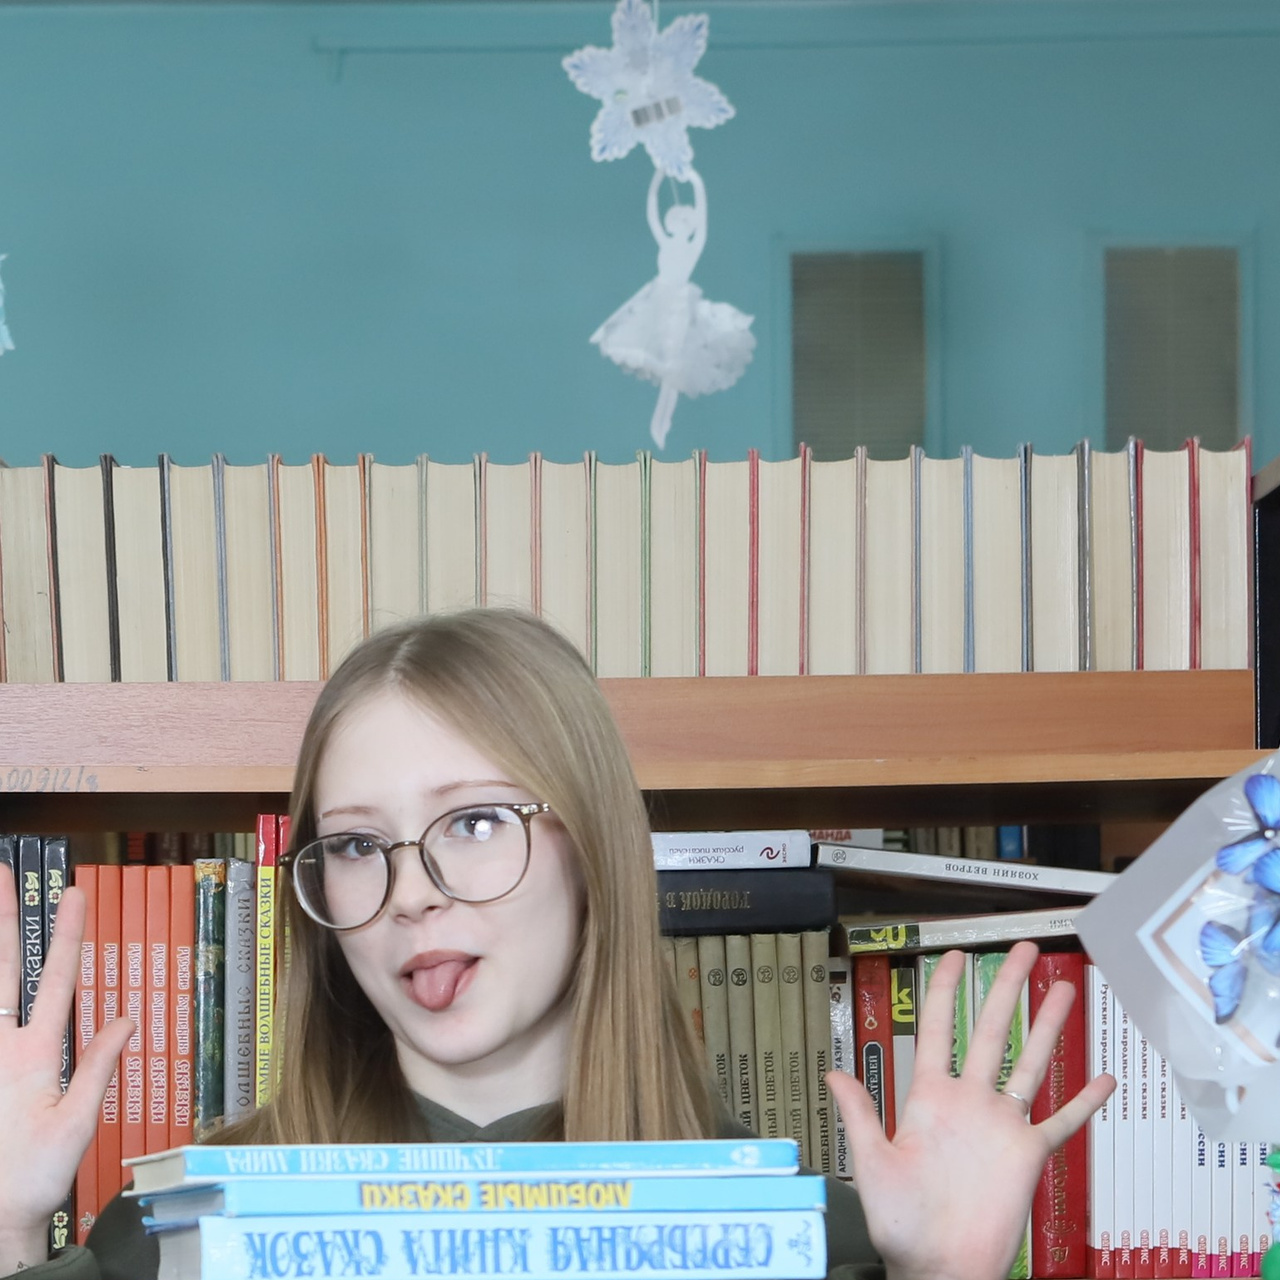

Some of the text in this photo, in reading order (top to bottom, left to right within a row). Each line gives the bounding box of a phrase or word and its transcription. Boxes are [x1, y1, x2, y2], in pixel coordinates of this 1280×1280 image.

[688, 856, 725, 864] СКАЗКИ
[945, 863, 1039, 881] ХОЗЯИН ВЕТРОВ
[259, 877, 272, 939] СКАЗКИ
[259, 943, 271, 1043] ВОЛШЕБНЫЕ
[739, 1054, 750, 1104] ЦВЕТОК
[764, 1051, 775, 1102] ЦВЕТОК
[789, 1052, 800, 1102] ЦВЕТОК
[224, 1148, 504, 1173] ЛУЧШИЕ СКАЗКИ МИРА
[360, 1181, 633, 1210] ЛЮБИМЫЕ СКАЗКИ
[243, 1223, 773, 1280] СЕРЕБРЯНАЯ КНИГА СКАЗОК
